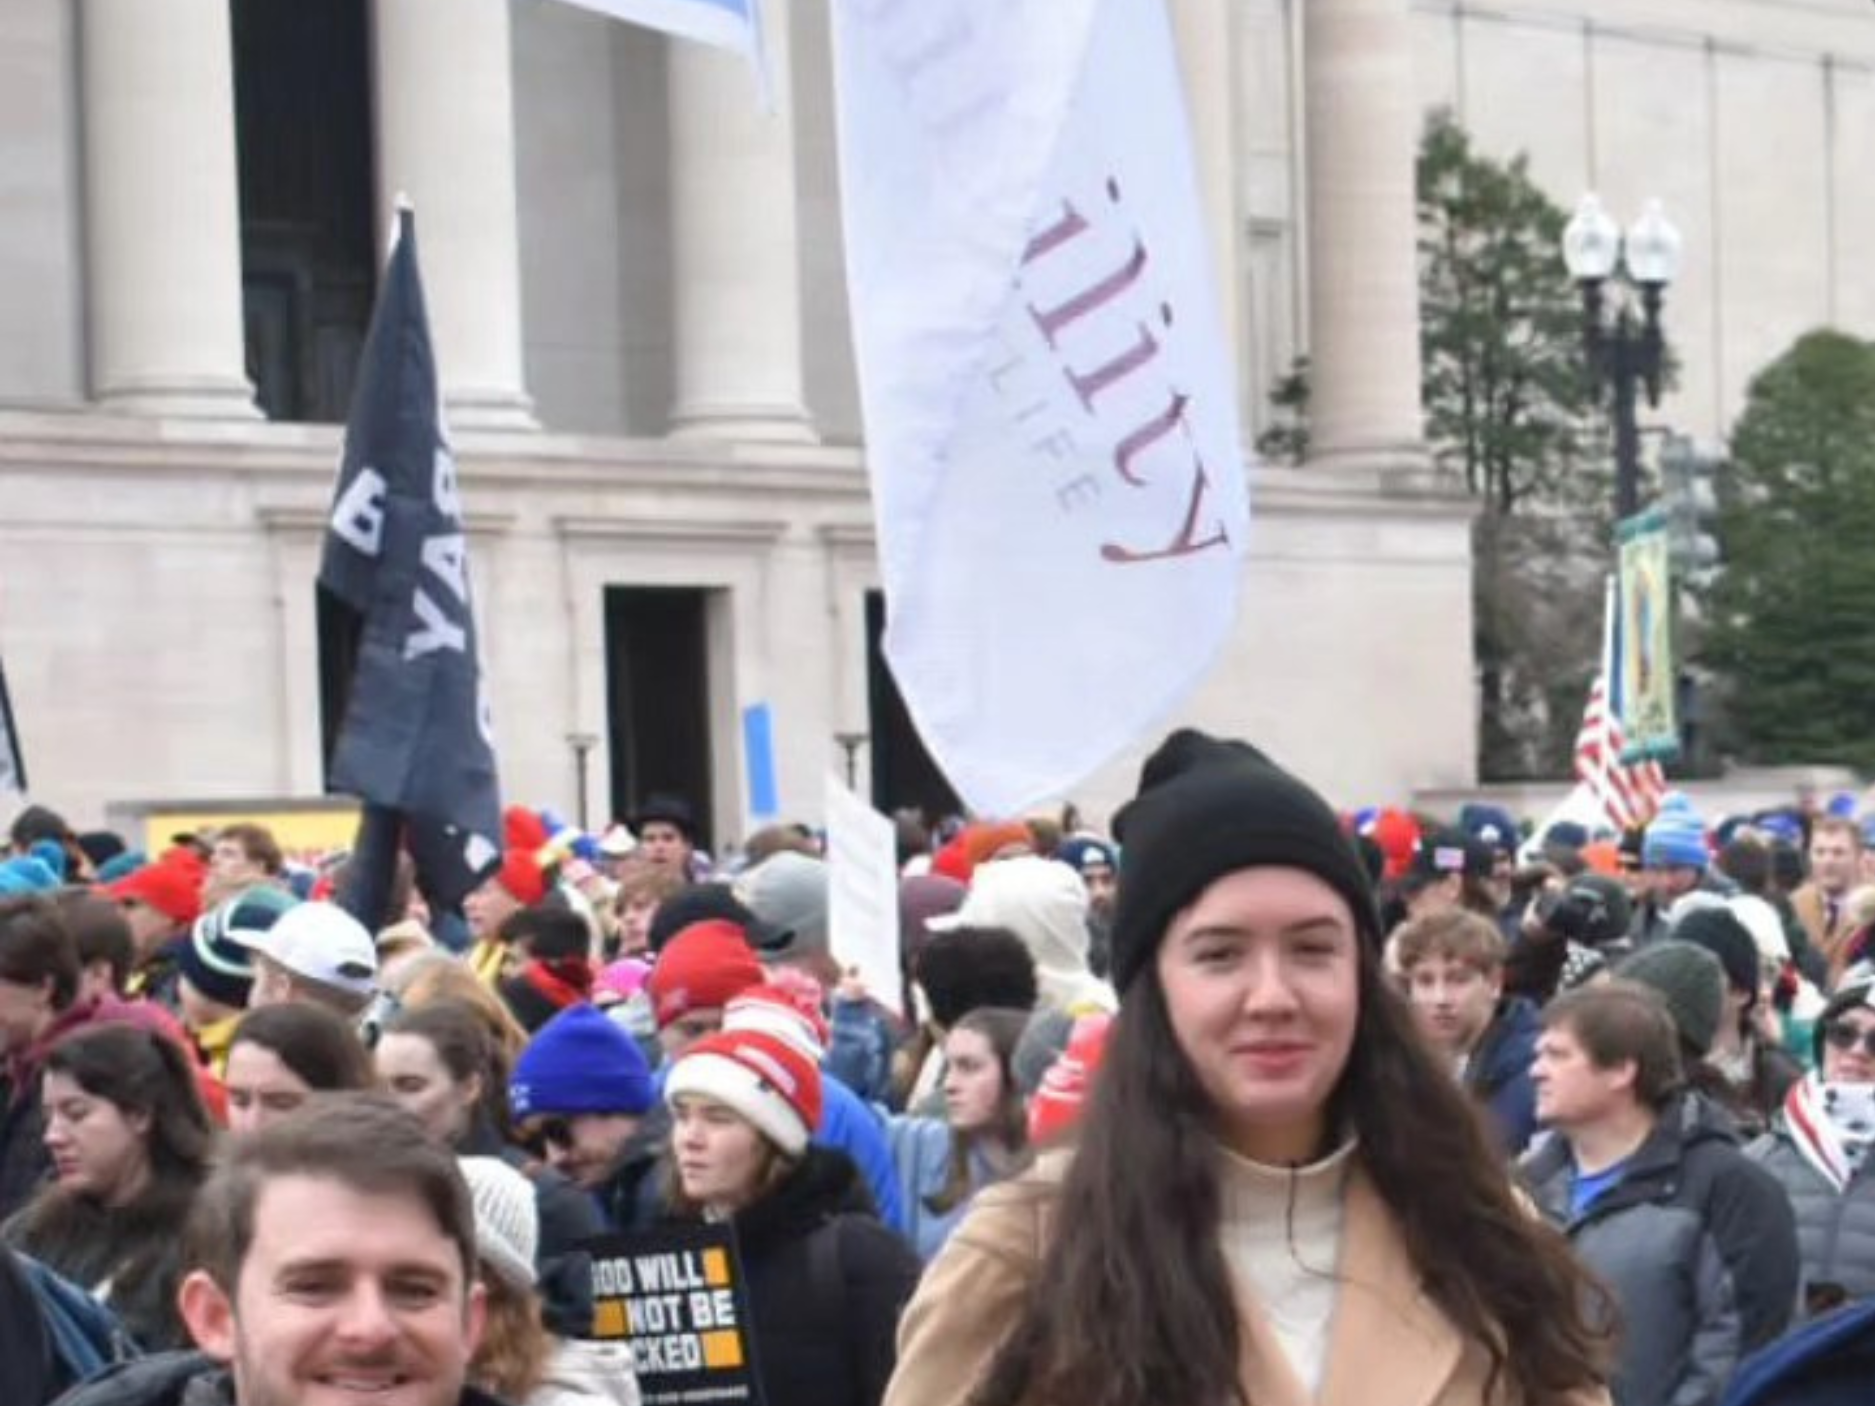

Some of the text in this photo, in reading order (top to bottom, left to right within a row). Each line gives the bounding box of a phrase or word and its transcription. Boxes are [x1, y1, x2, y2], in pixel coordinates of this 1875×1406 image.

[986, 354, 1104, 514] LIFE
[635, 1250, 704, 1293] WILL
[625, 1288, 736, 1335] NOT BE
